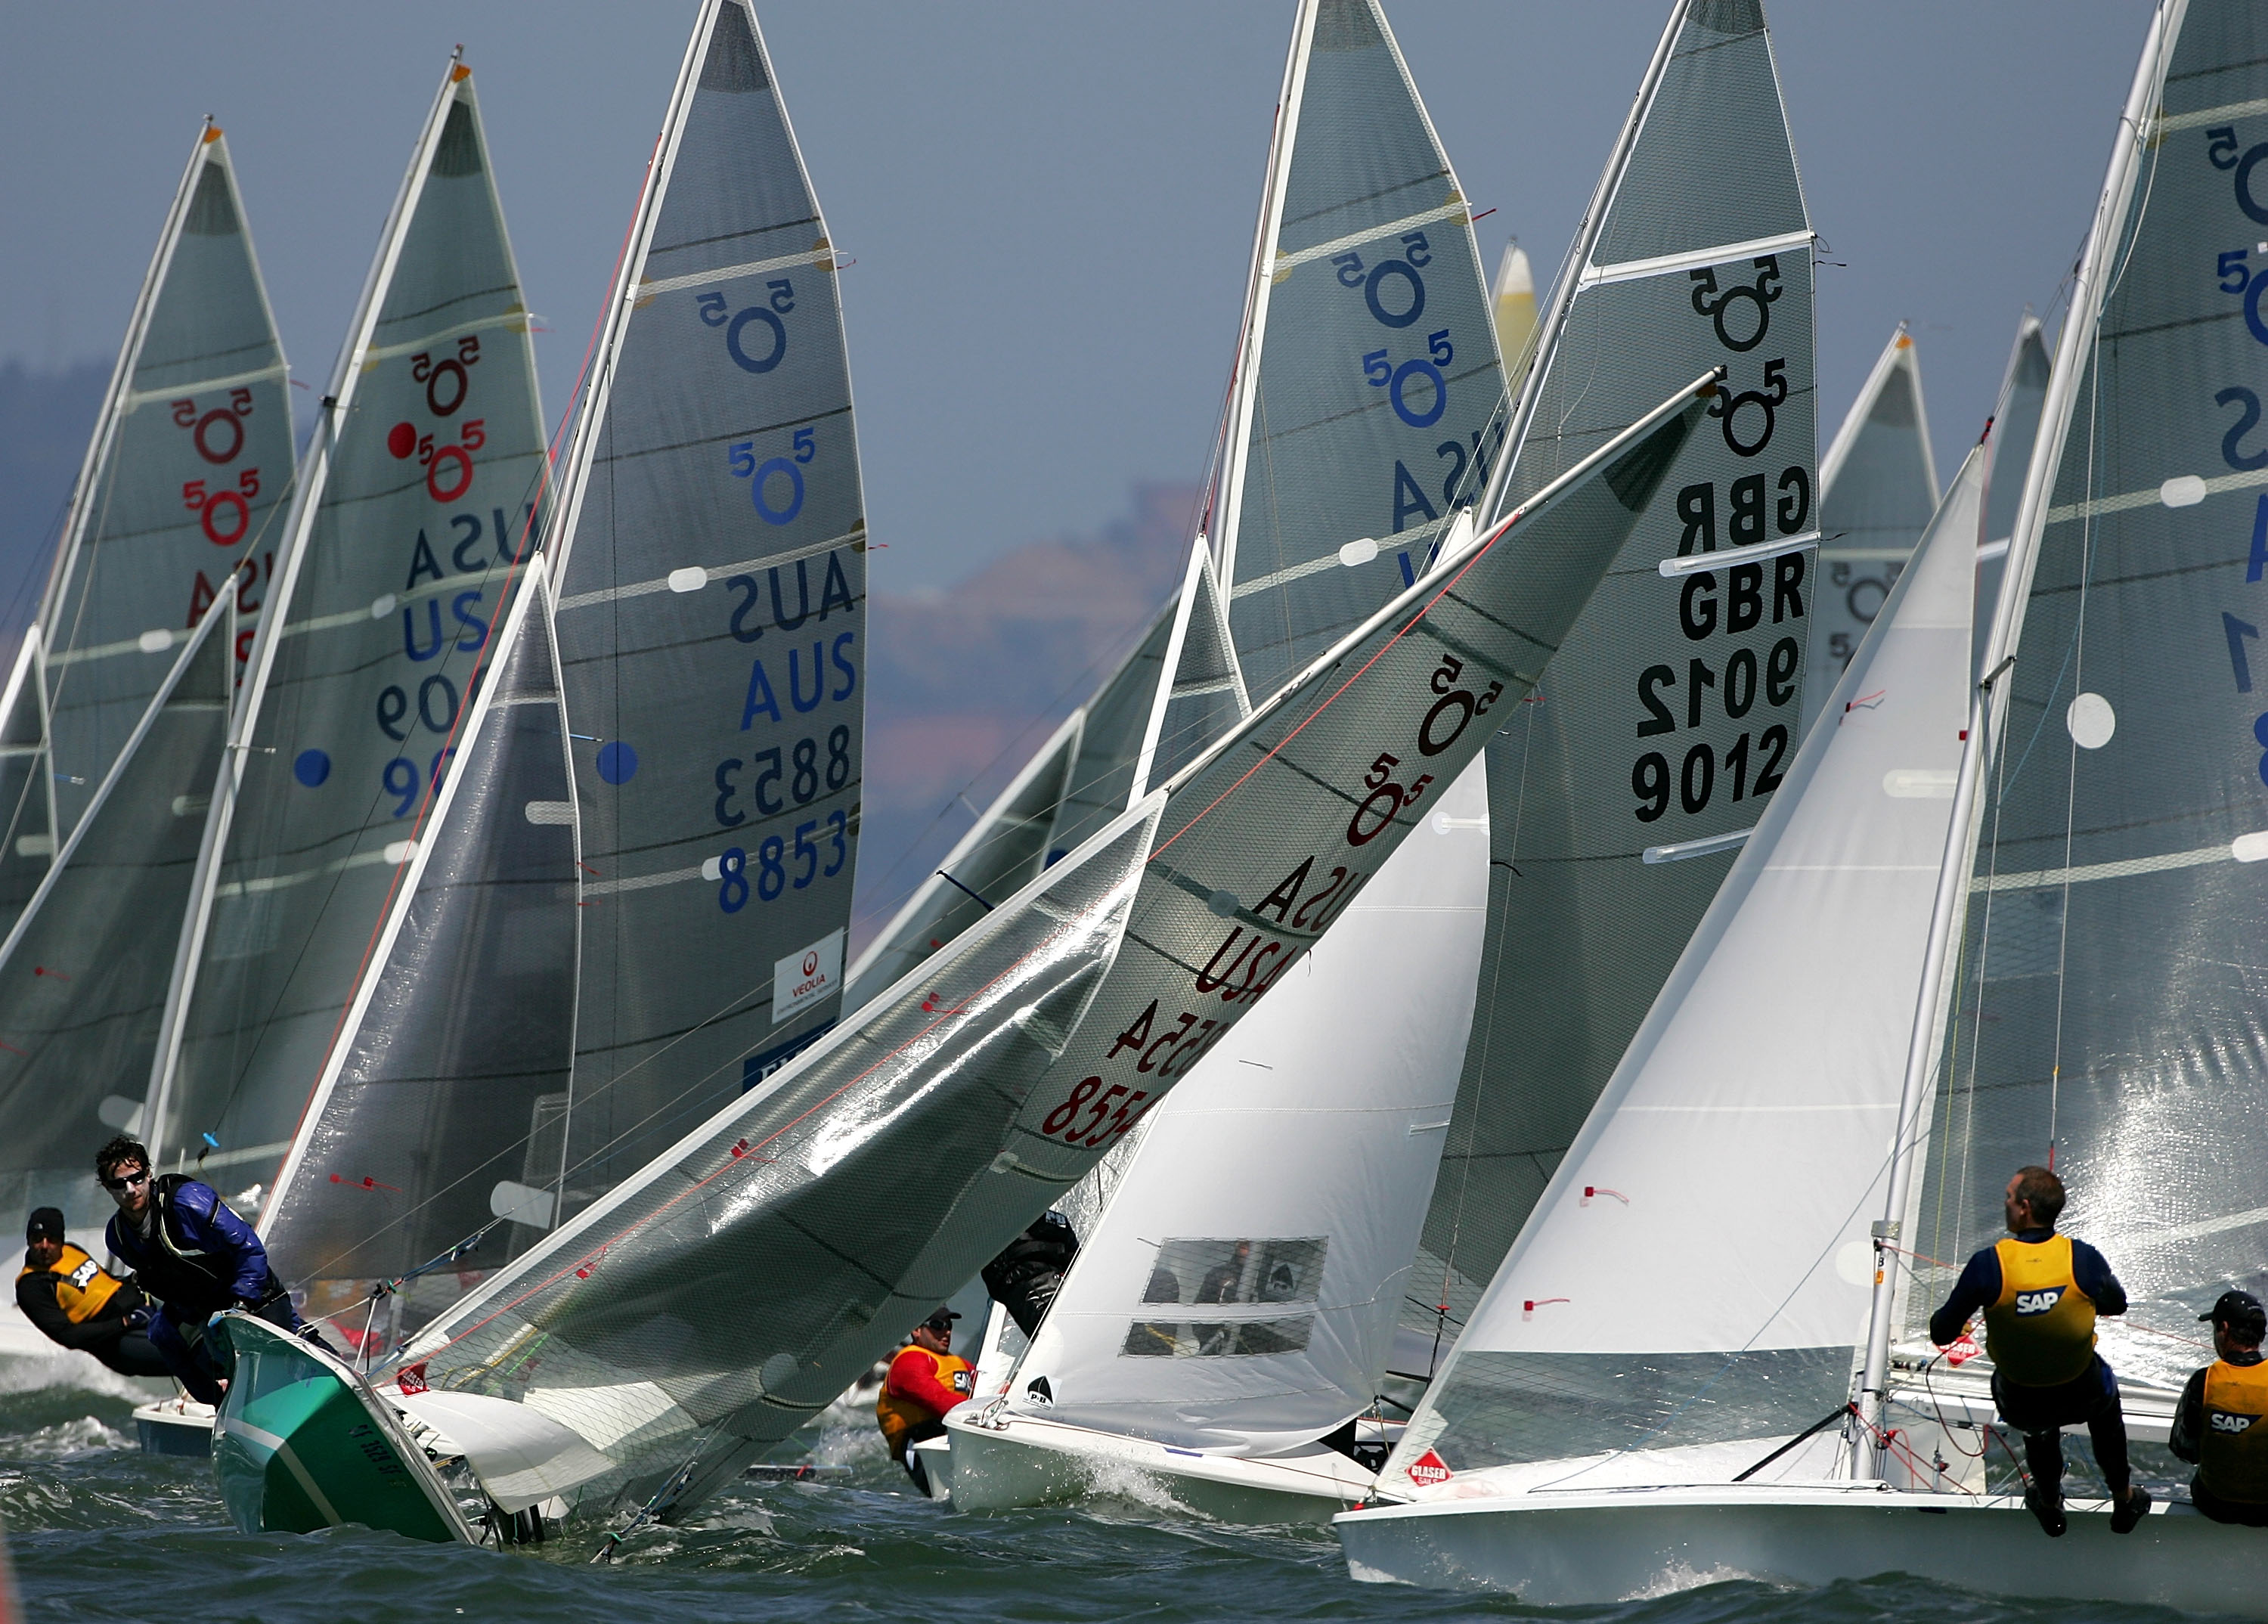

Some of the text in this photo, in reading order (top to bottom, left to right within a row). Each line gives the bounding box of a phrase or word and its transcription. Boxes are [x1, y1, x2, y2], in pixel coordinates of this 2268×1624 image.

[1679, 552, 1805, 641] GBR
[739, 632, 856, 731] AUS
[1631, 724, 1789, 823] 9012
[719, 809, 847, 913] 8853
[792, 973, 826, 997] VEOLIA
[1195, 926, 1298, 1005] USA
[2016, 1291, 2059, 1313] SAP
[2211, 1413, 2251, 1433] SAP
[1411, 1464, 1446, 1480] GLASER
